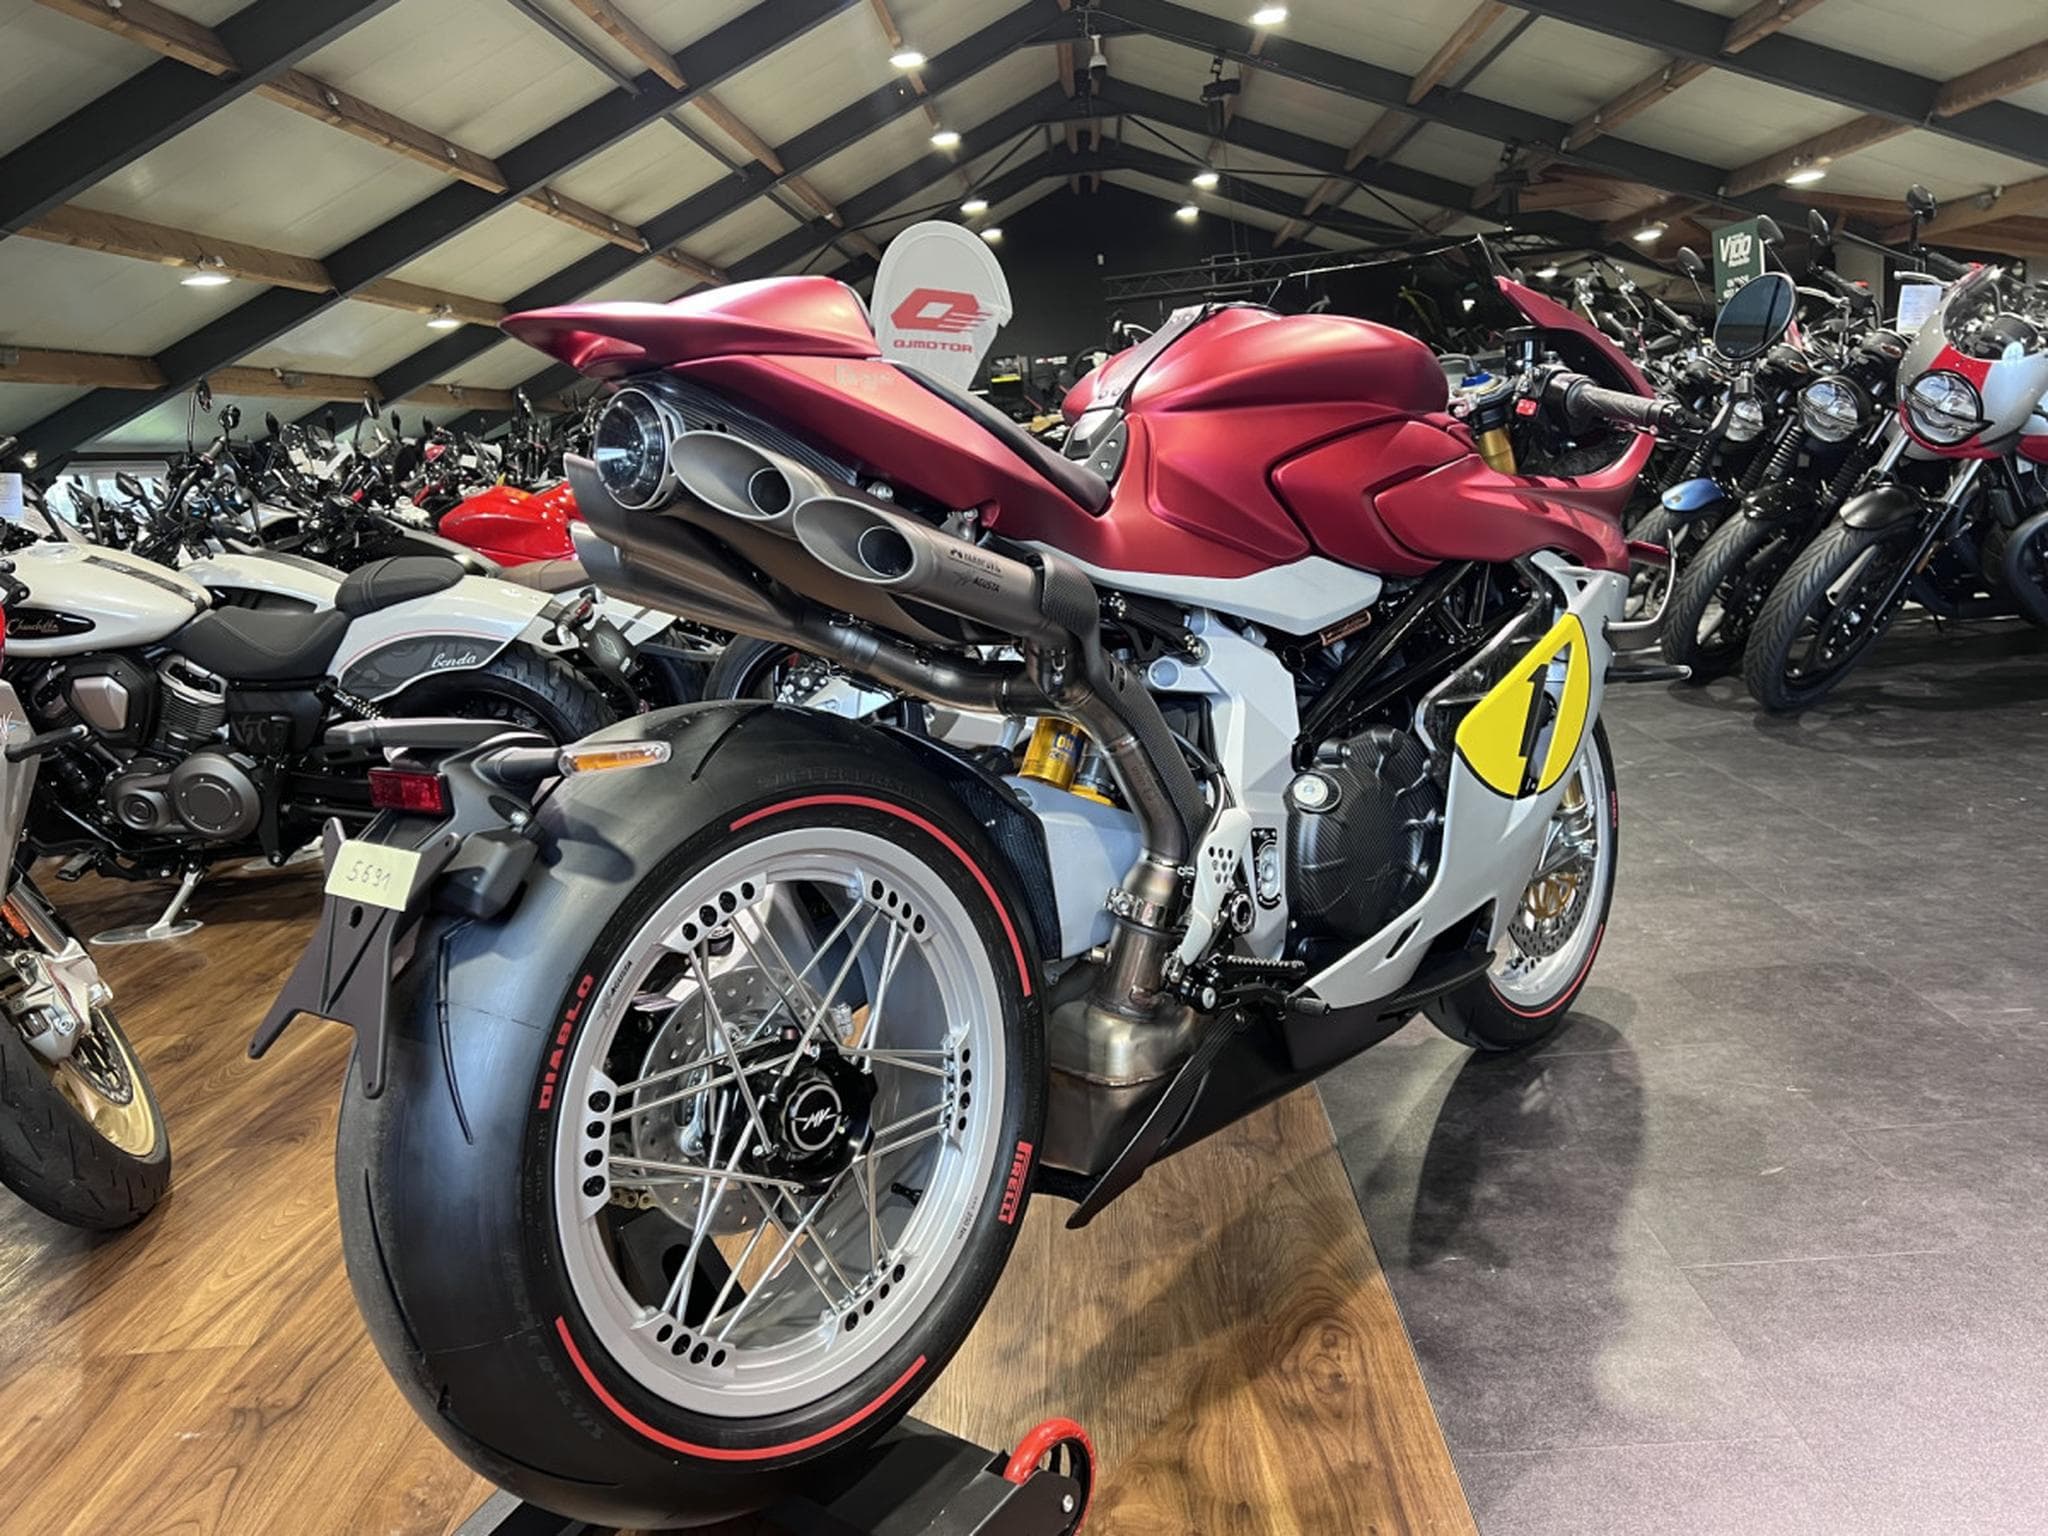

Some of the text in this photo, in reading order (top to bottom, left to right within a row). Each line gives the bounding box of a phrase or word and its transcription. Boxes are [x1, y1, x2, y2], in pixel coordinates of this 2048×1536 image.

[893, 339, 973, 353] QJMOTOR
[538, 973, 595, 1109] DIABLO
[998, 1141, 1033, 1224] PIRELLI
